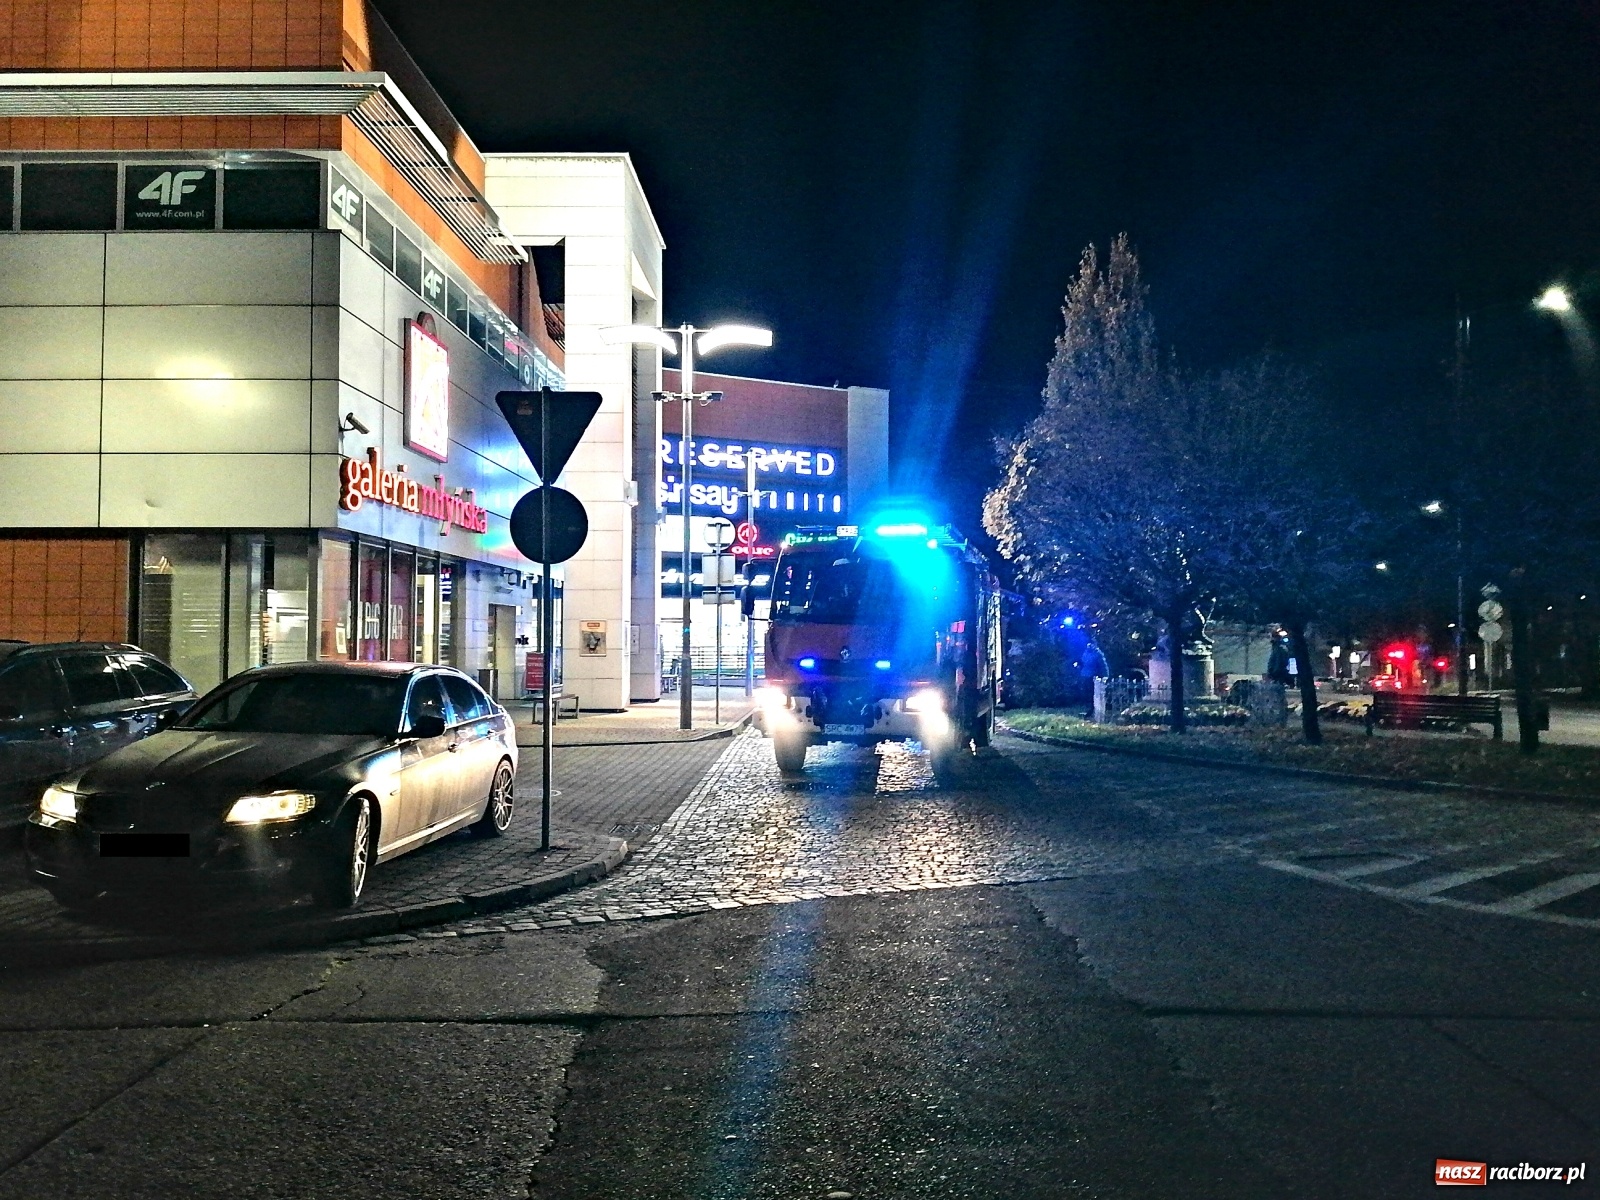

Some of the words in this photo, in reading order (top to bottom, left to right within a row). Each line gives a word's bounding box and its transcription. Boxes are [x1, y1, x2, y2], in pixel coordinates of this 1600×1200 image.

[138, 171, 206, 206] 4F
[332, 184, 360, 222] 4F
[424, 269, 443, 299] 4F
[657, 439, 835, 476] RESERVED
[345, 447, 420, 512] galeria
[421, 474, 488, 536] młyńska
